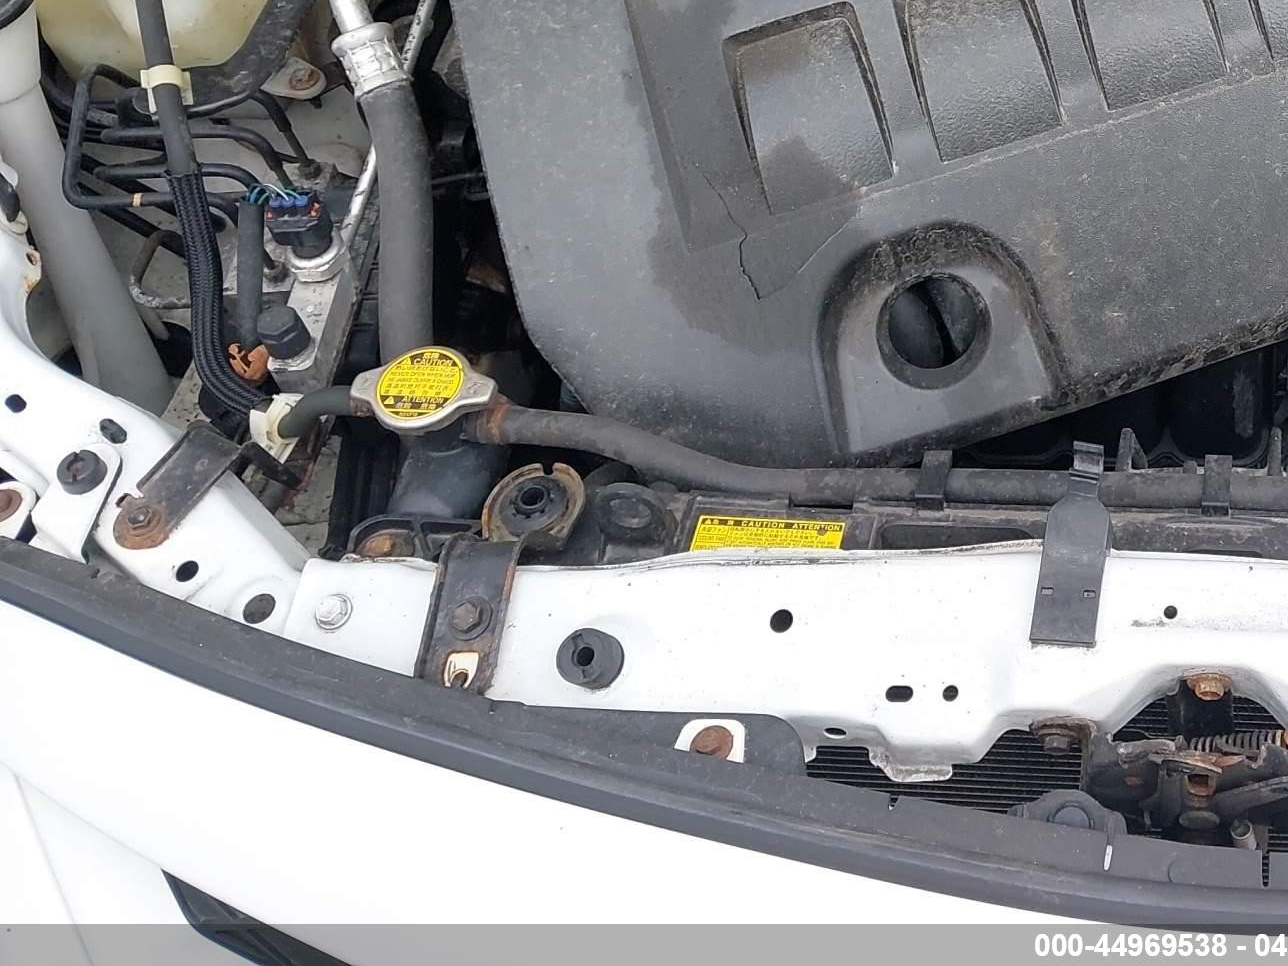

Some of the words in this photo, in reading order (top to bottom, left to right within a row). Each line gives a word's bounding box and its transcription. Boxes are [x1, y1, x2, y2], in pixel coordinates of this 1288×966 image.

[413, 358, 454, 367] CAUTION
[401, 395, 445, 404] ATTENTION
[741, 520, 785, 528] CAUTION
[792, 523, 841, 531] ATTENTION
